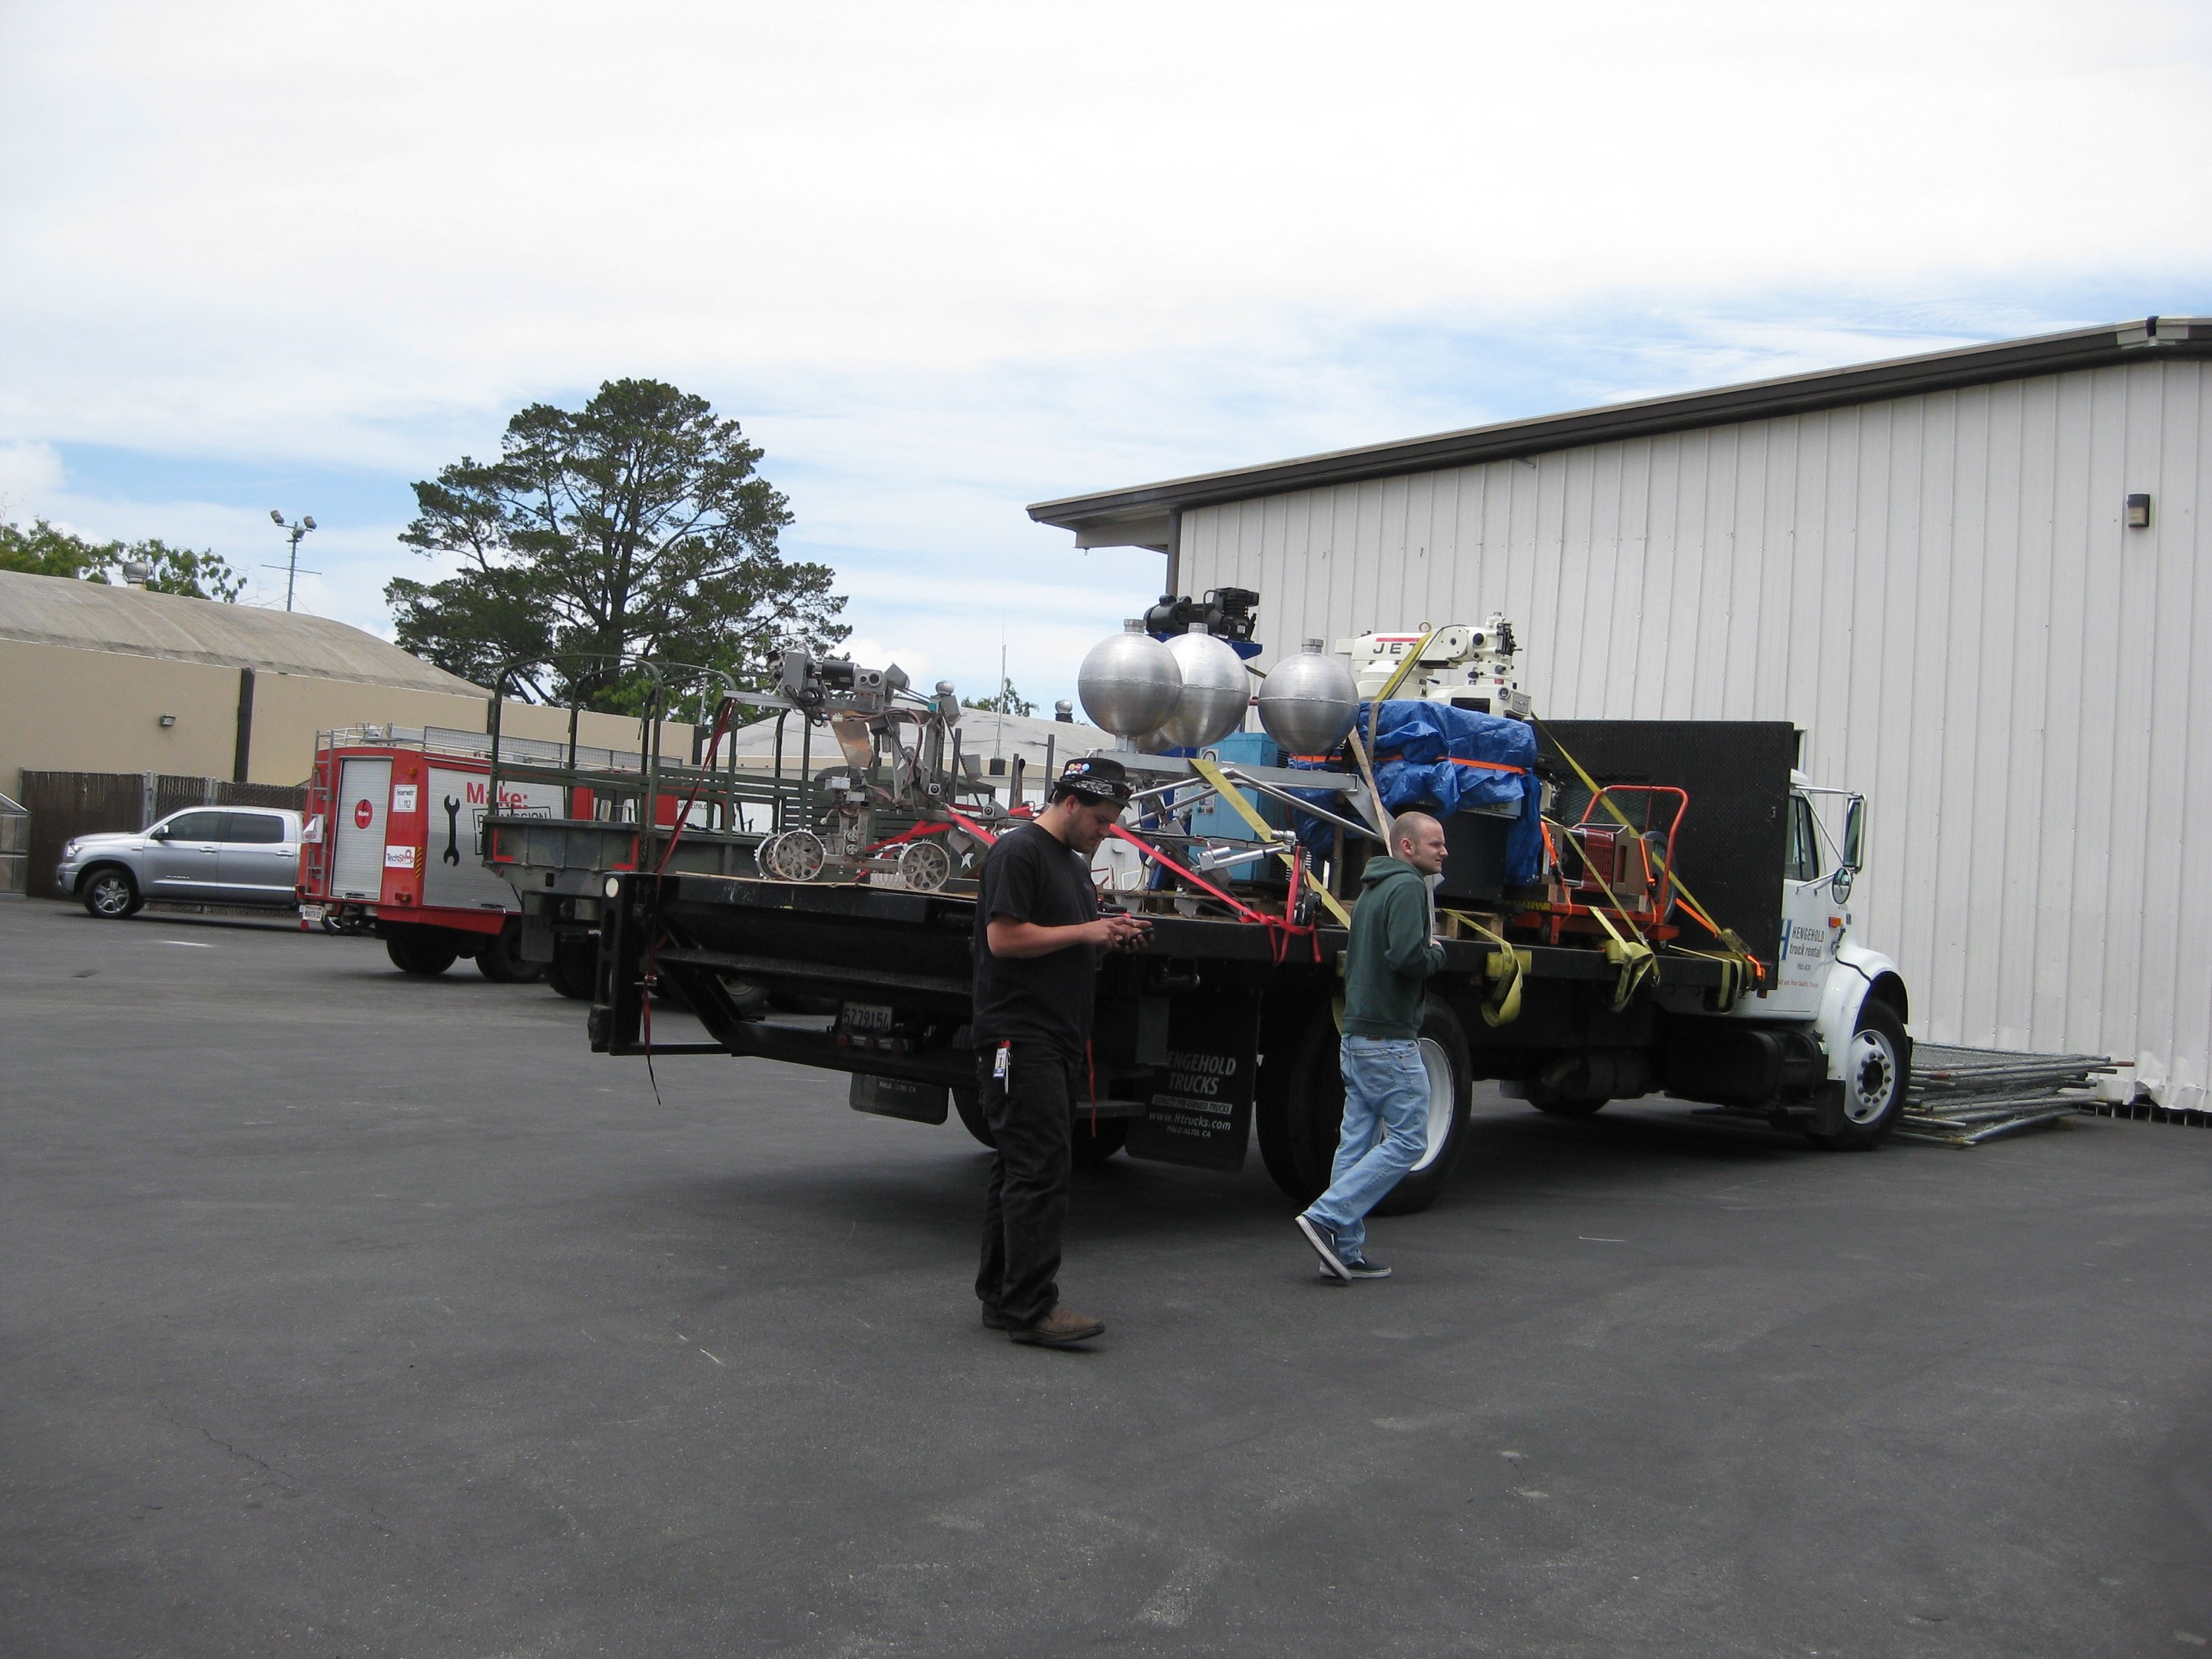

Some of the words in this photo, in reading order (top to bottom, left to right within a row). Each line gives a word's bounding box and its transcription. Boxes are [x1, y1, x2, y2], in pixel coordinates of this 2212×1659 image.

[466, 782, 528, 810] Mke:
[1792, 926, 1825, 942] HENGEHOLD
[1790, 943, 1804, 955] truck
[1805, 945, 1821, 958] rental
[1163, 1051, 1237, 1075] ENGEHOLD
[879, 1081, 892, 1090] PALO
[895, 1084, 908, 1092] LTO,
[1168, 1072, 1220, 1094] TRUCKS
[1209, 1103, 1230, 1113] TRUCKS
[1149, 1112, 1231, 1131] www.Htrucks.com
[1167, 1125, 1183, 1134] PALO
[1184, 1128, 1200, 1137] ALTO,
[1202, 1130, 1211, 1138] CA
